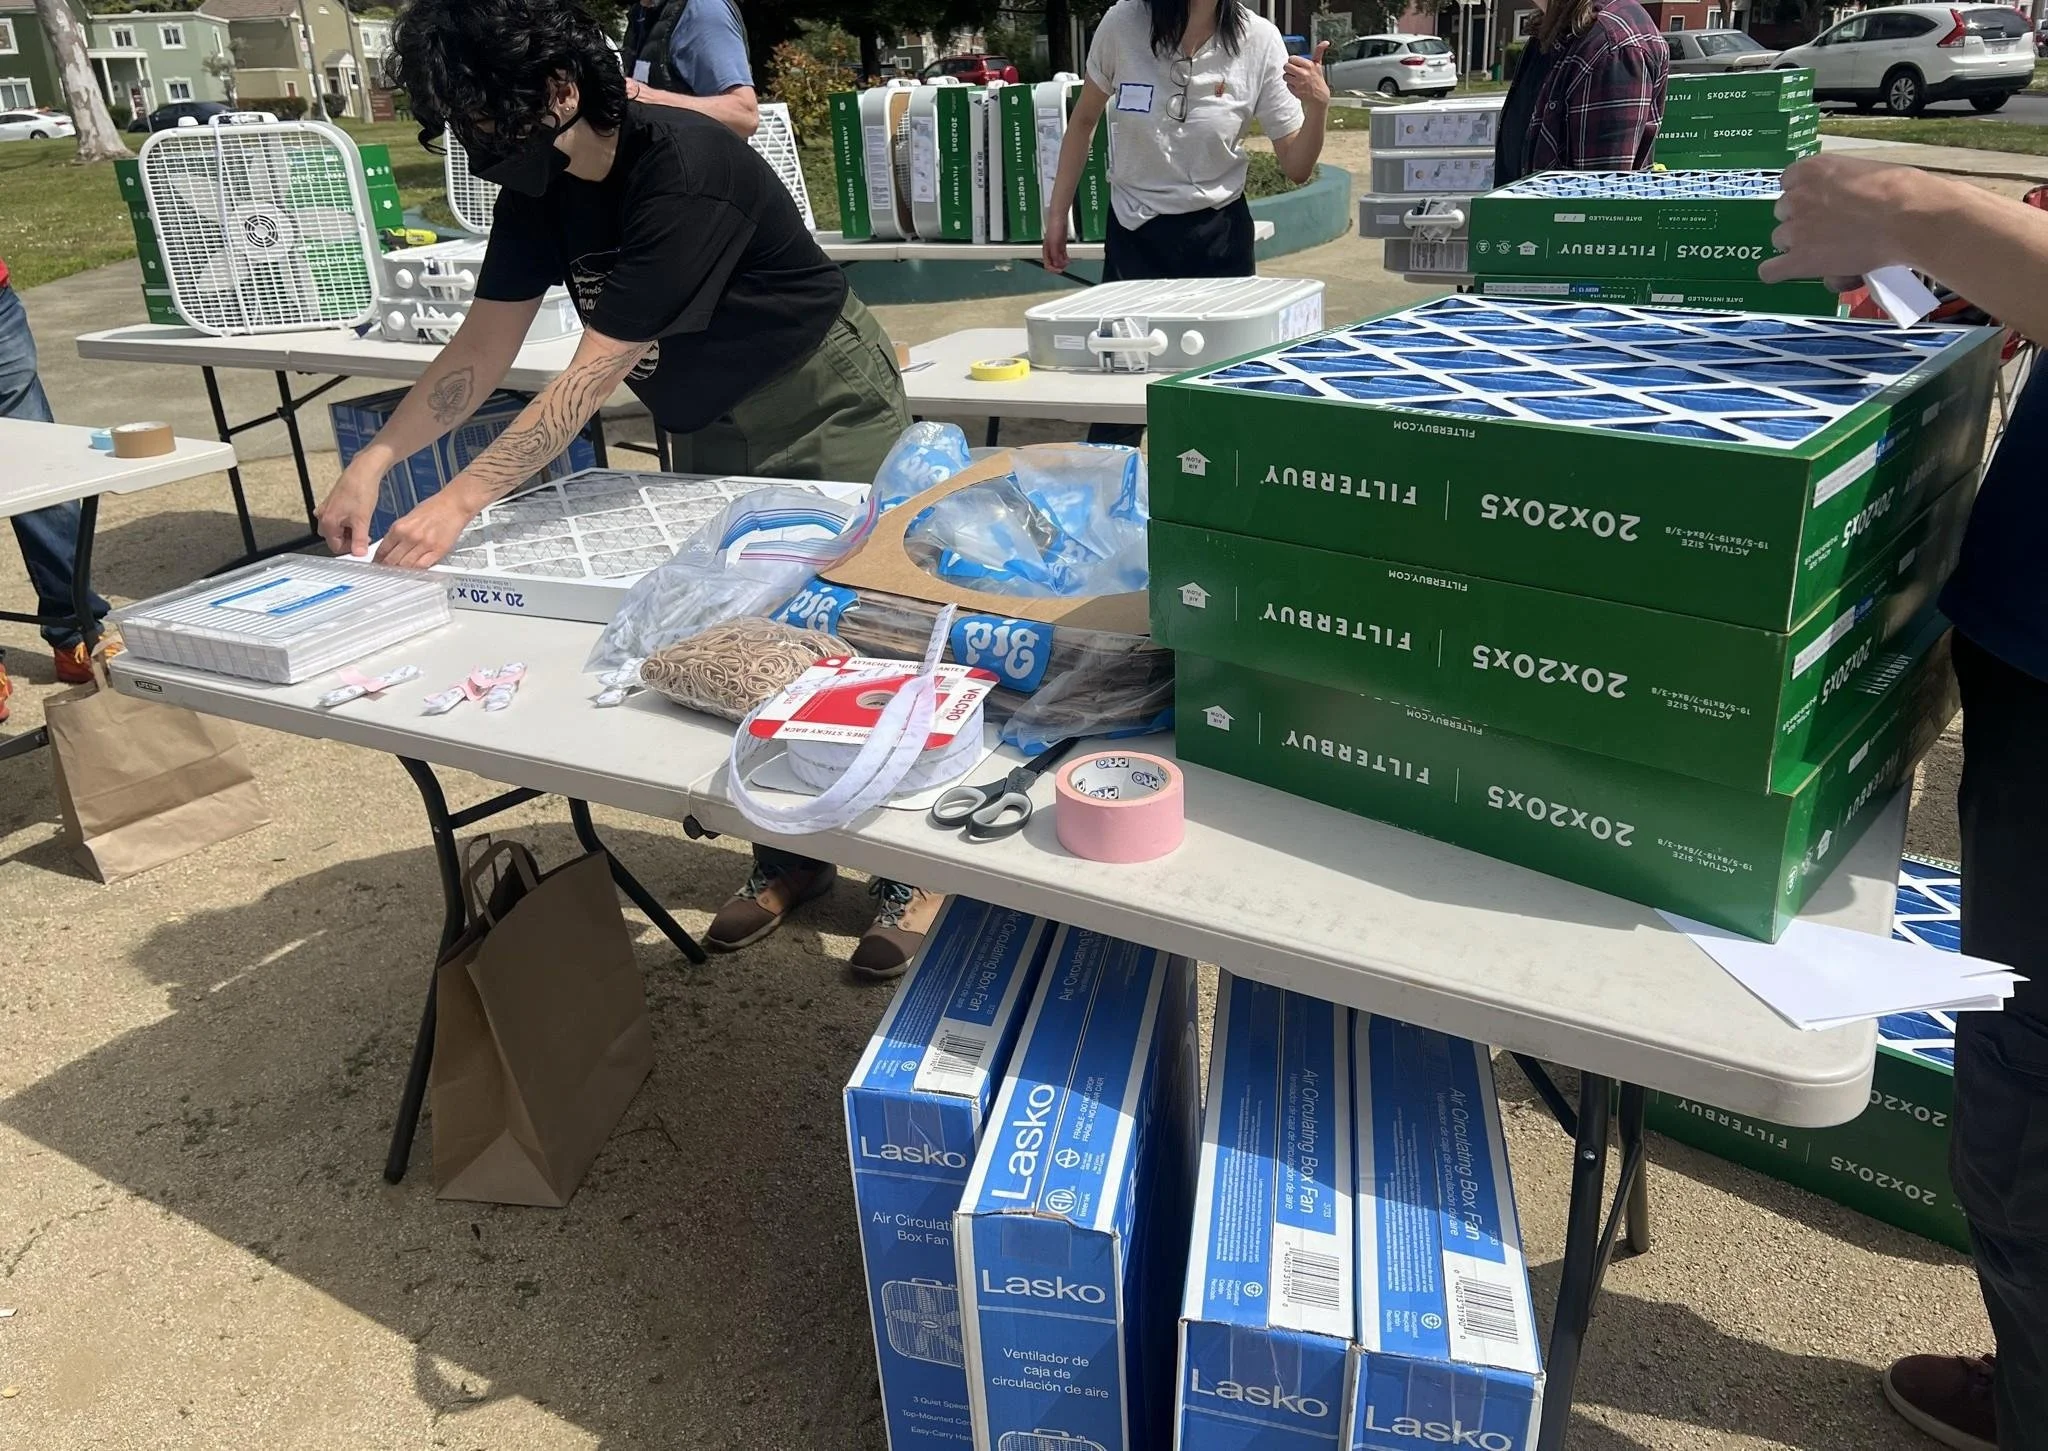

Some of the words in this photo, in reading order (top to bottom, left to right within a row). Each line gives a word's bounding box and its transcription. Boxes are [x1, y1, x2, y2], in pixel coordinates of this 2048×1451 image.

[1665, 93, 1692, 102] FILTE
[1707, 90, 1747, 100] 20x20x5
[1713, 128, 1753, 138] 20x20x5
[1560, 244, 1656, 257] FILTERBUY
[1677, 244, 1763, 260] 20x20x5
[1393, 420, 1476, 438] FILTERBUY.COM
[1263, 465, 1417, 505] FILTERBUY
[1481, 493, 1641, 542] 20x20x5
[1665, 526, 1769, 550] 19-5/8x19-7/8x4-3/8
[1681, 538, 1705, 550] SIZE
[1709, 542, 1750, 556] ACTUAL
[1388, 569, 1468, 592] FILTERBUY.COM
[471, 588, 489, 604] 20
[492, 591, 502, 602] x
[506, 593, 524, 607] 20
[1263, 602, 1412, 651] FILTERBUY
[1472, 645, 1628, 698] 20x20x5
[1821, 635, 1873, 706] 20x20x5
[1666, 699, 1689, 711] SIZE
[1693, 704, 1733, 720] ACTUAL
[783, 727, 808, 735] BACK
[1406, 709, 1483, 735] FILTERBUY.COM
[1286, 730, 1430, 785] FILTERBUY
[1487, 785, 1635, 847] 20x20x5
[1672, 850, 1693, 863] SIZE
[1697, 858, 1735, 874] ACTUAL
[982, 922, 1017, 970] Circulating
[975, 970, 997, 990] Box
[966, 991, 989, 1012] Fan
[1057, 986, 1075, 1001] Air
[1302, 1068, 1318, 1088] Air
[1448, 1087, 1466, 1107] Air
[1871, 1089, 1948, 1127] 20x20
[1072, 1115, 1085, 1139] FRAGILE
[1297, 1085, 1319, 1153] Circulating
[1678, 1098, 1788, 1150] FILTERBUY
[989, 1080, 1059, 1200] Lasko
[1447, 1105, 1476, 1177] Circulating
[860, 1135, 967, 1169] Lasko
[1299, 1155, 1317, 1185] Box
[1830, 1156, 1937, 1206] 20x20x5
[1298, 1185, 1318, 1214] Fan
[1458, 1177, 1480, 1208] Box
[872, 1211, 891, 1225] Air
[895, 1213, 954, 1232] Circulati
[1461, 1210, 1484, 1241] Fan
[897, 1230, 922, 1243] Box
[925, 1233, 949, 1246] Fan
[982, 1269, 1106, 1304] Lasko
[1456, 1304, 1465, 1326] 31190
[1003, 1348, 1069, 1365] Ventilador
[1072, 1355, 1089, 1367] de
[1024, 1364, 1051, 1379] caja
[1054, 1367, 1070, 1379] de
[992, 1375, 1054, 1392] circulación
[1064, 1383, 1081, 1394] de
[1084, 1387, 1109, 1399] aire
[1191, 1368, 1328, 1417] Lasko
[920, 1397, 941, 1406] Quiet
[943, 1400, 969, 1411] Speed
[902, 1409, 954, 1424] Top-Mounted
[911, 1425, 953, 1440] Easy-Carry
[1365, 1405, 1513, 1451] Lasko
